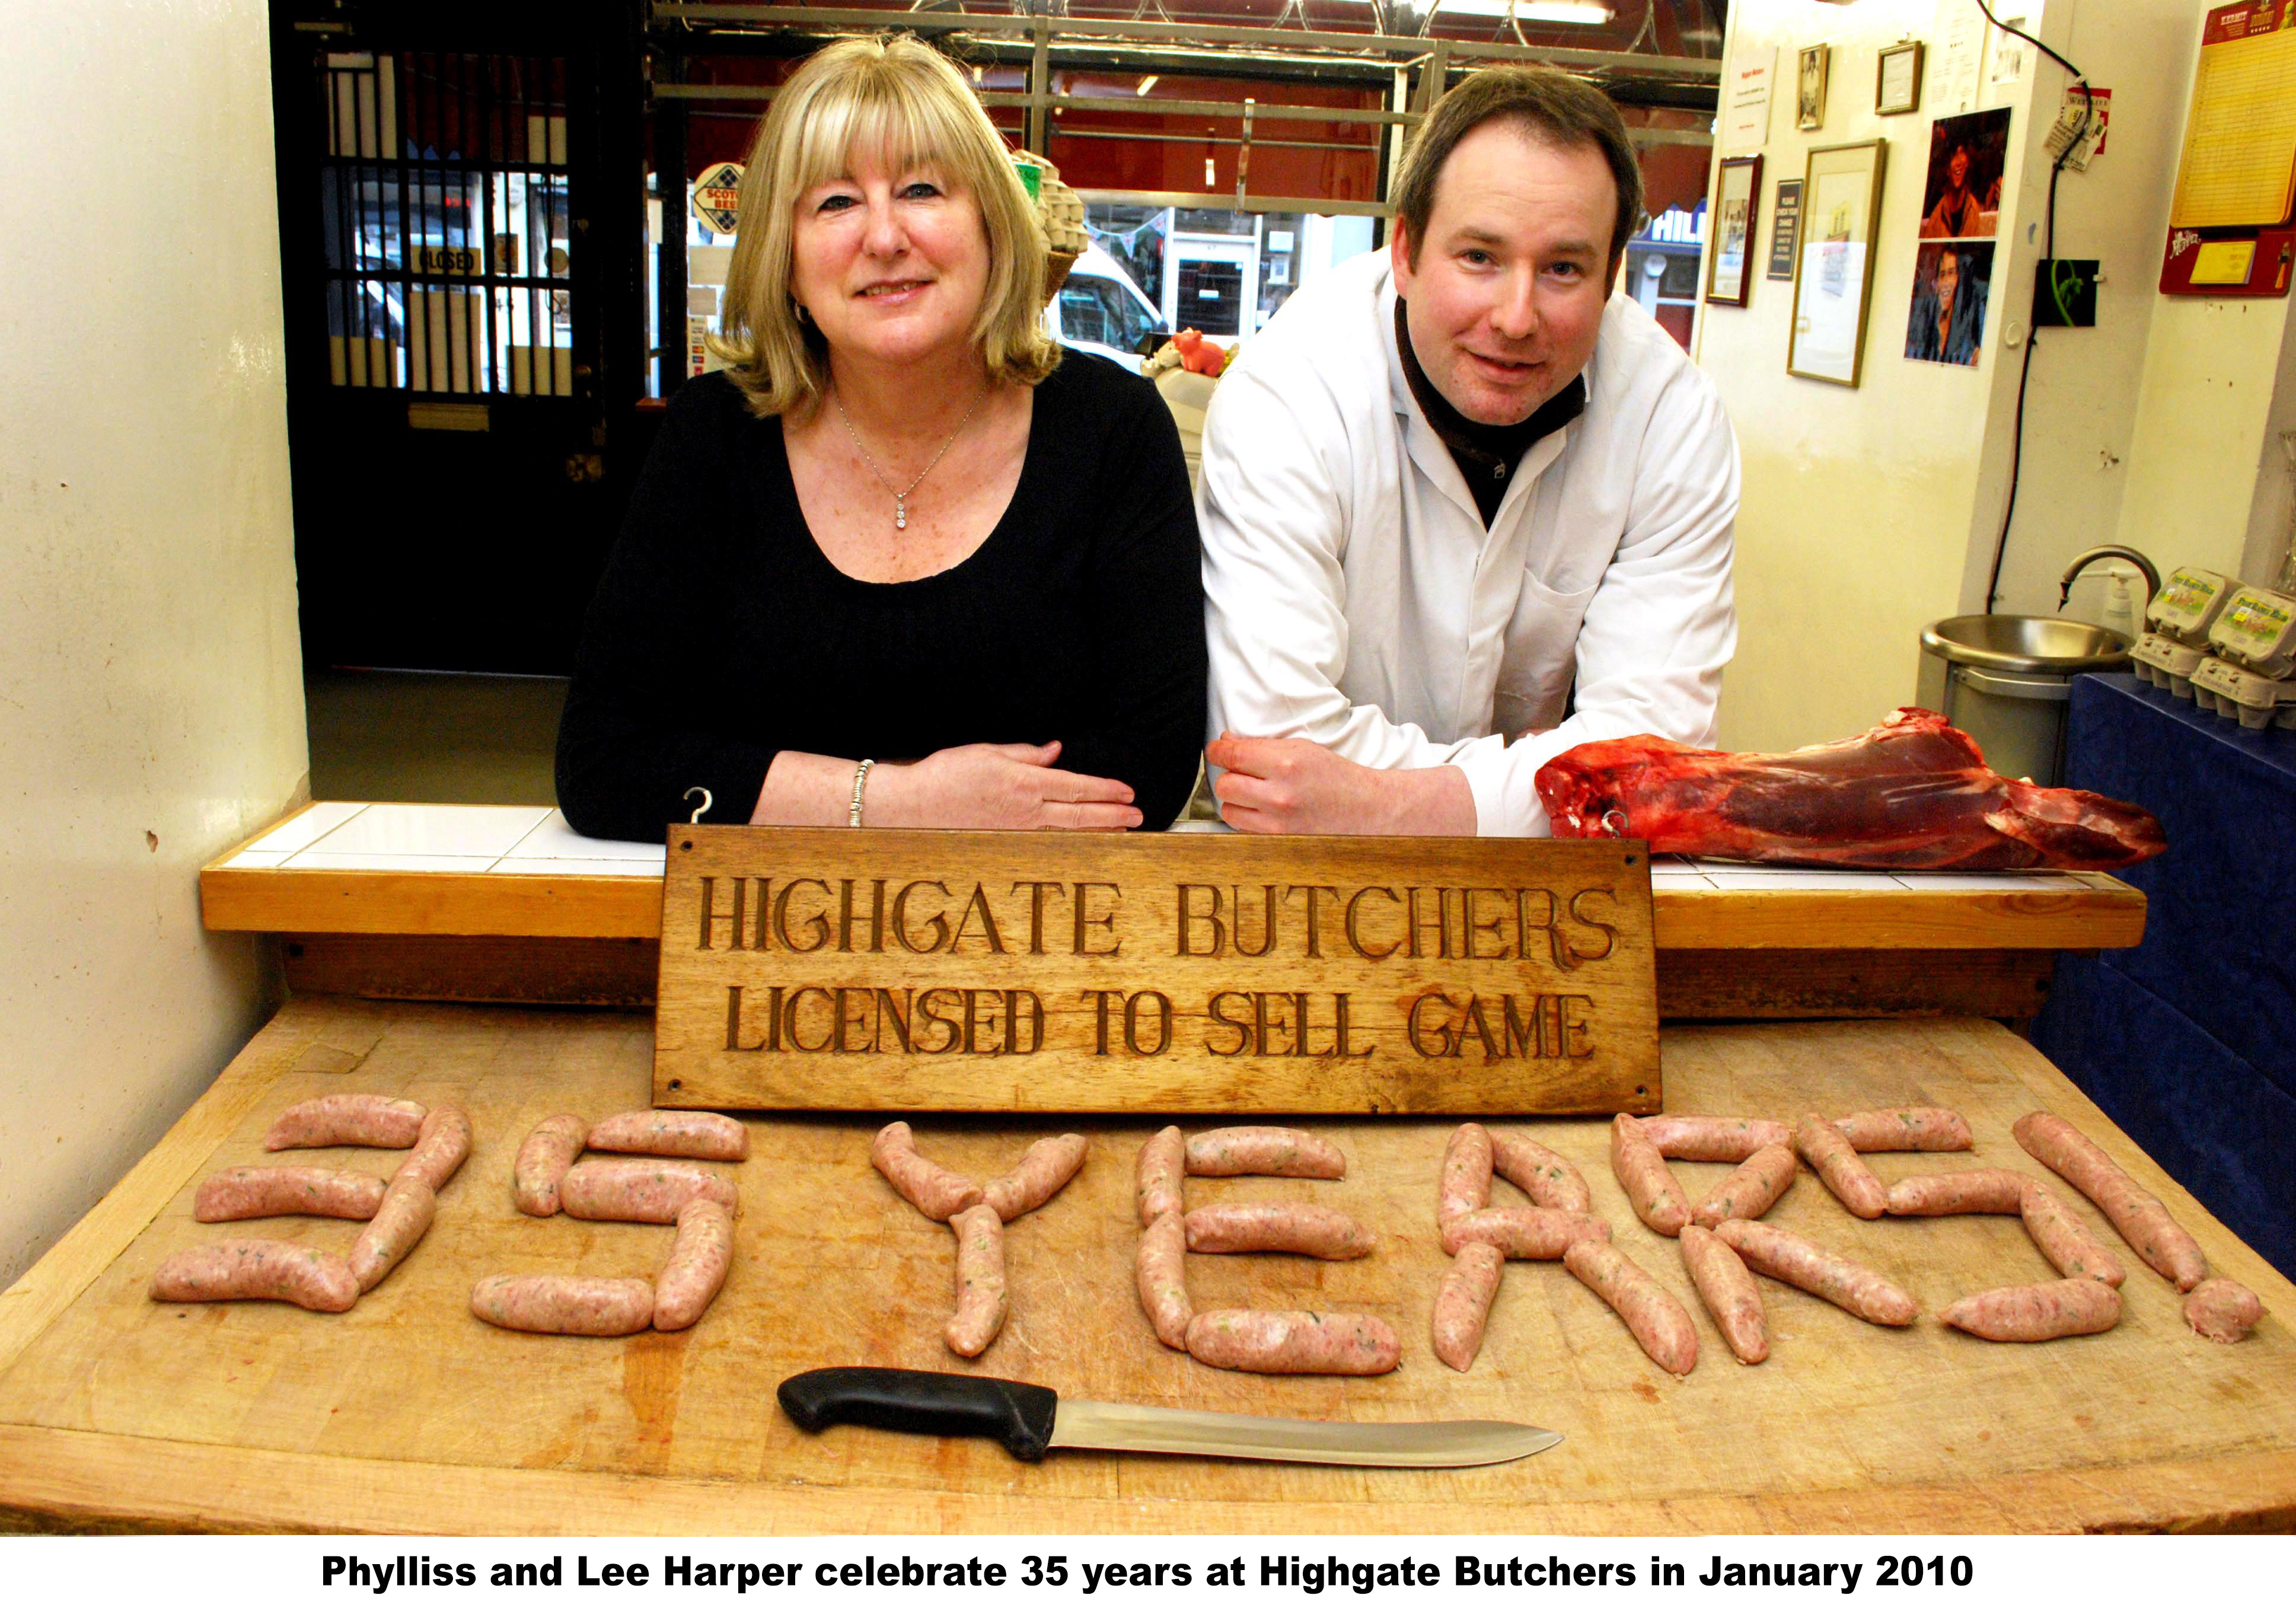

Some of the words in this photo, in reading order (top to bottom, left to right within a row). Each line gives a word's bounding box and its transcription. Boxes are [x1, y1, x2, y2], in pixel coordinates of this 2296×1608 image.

[696, 876, 1123, 956] HIGHGATE
[1173, 883, 1621, 971] BUTCHERS
[723, 985, 1045, 1055] LICENSED
[1079, 989, 1172, 1057] TO
[1204, 991, 1376, 1058] SELL
[1407, 992, 1596, 1061] GAME
